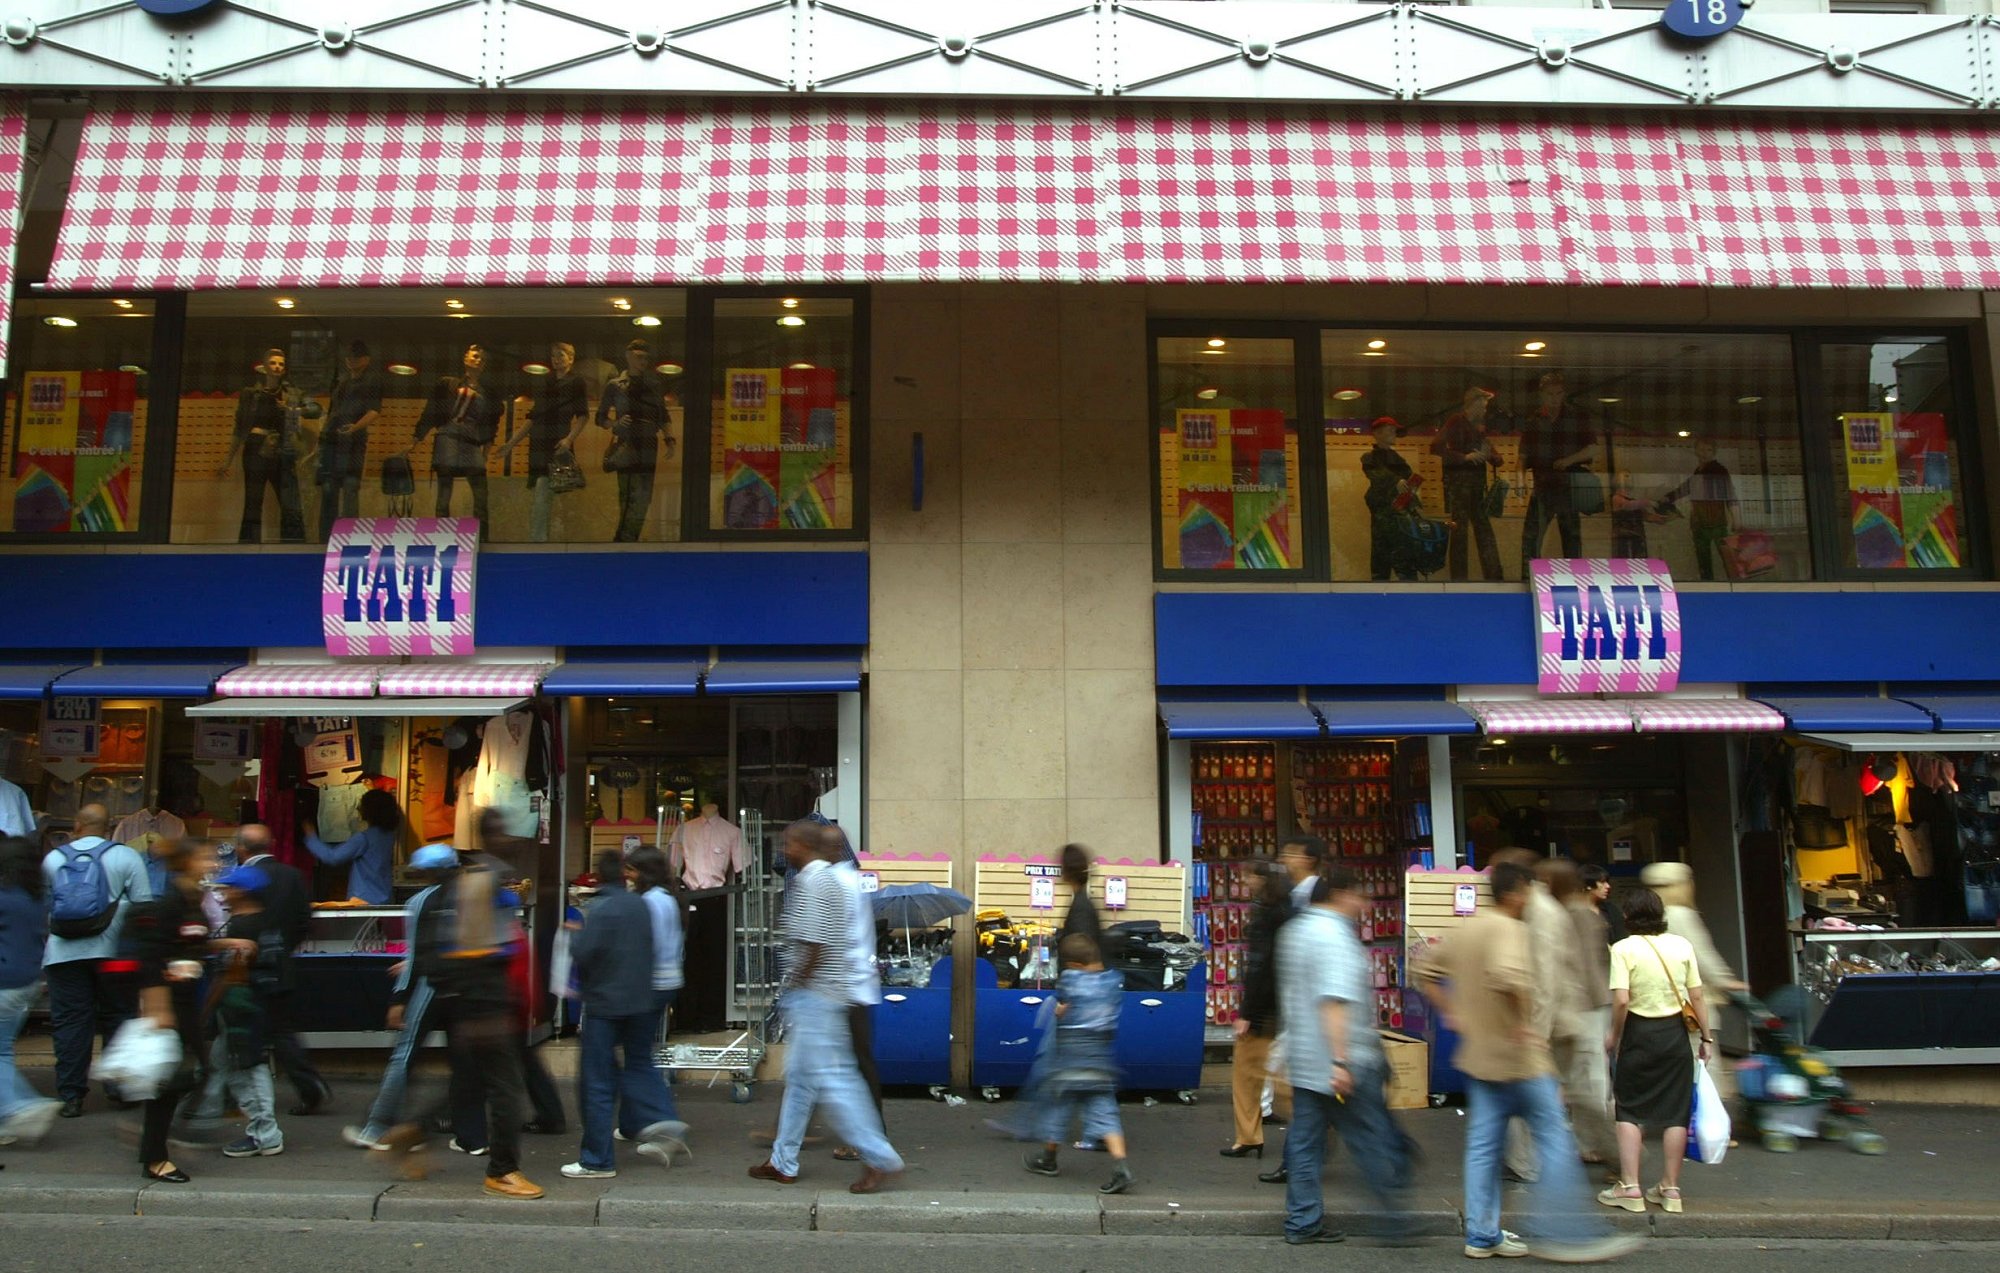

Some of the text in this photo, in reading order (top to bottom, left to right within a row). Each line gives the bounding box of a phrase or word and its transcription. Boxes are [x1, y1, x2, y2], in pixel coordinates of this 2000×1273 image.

[1687, 0, 1727, 25] 18
[1184, 420, 1212, 440] TATI
[338, 545, 459, 622] TATI
[1550, 585, 1666, 660] TATI
[55, 708, 92, 720] TATI
[1025, 866, 1062, 876] PRIX TATI
